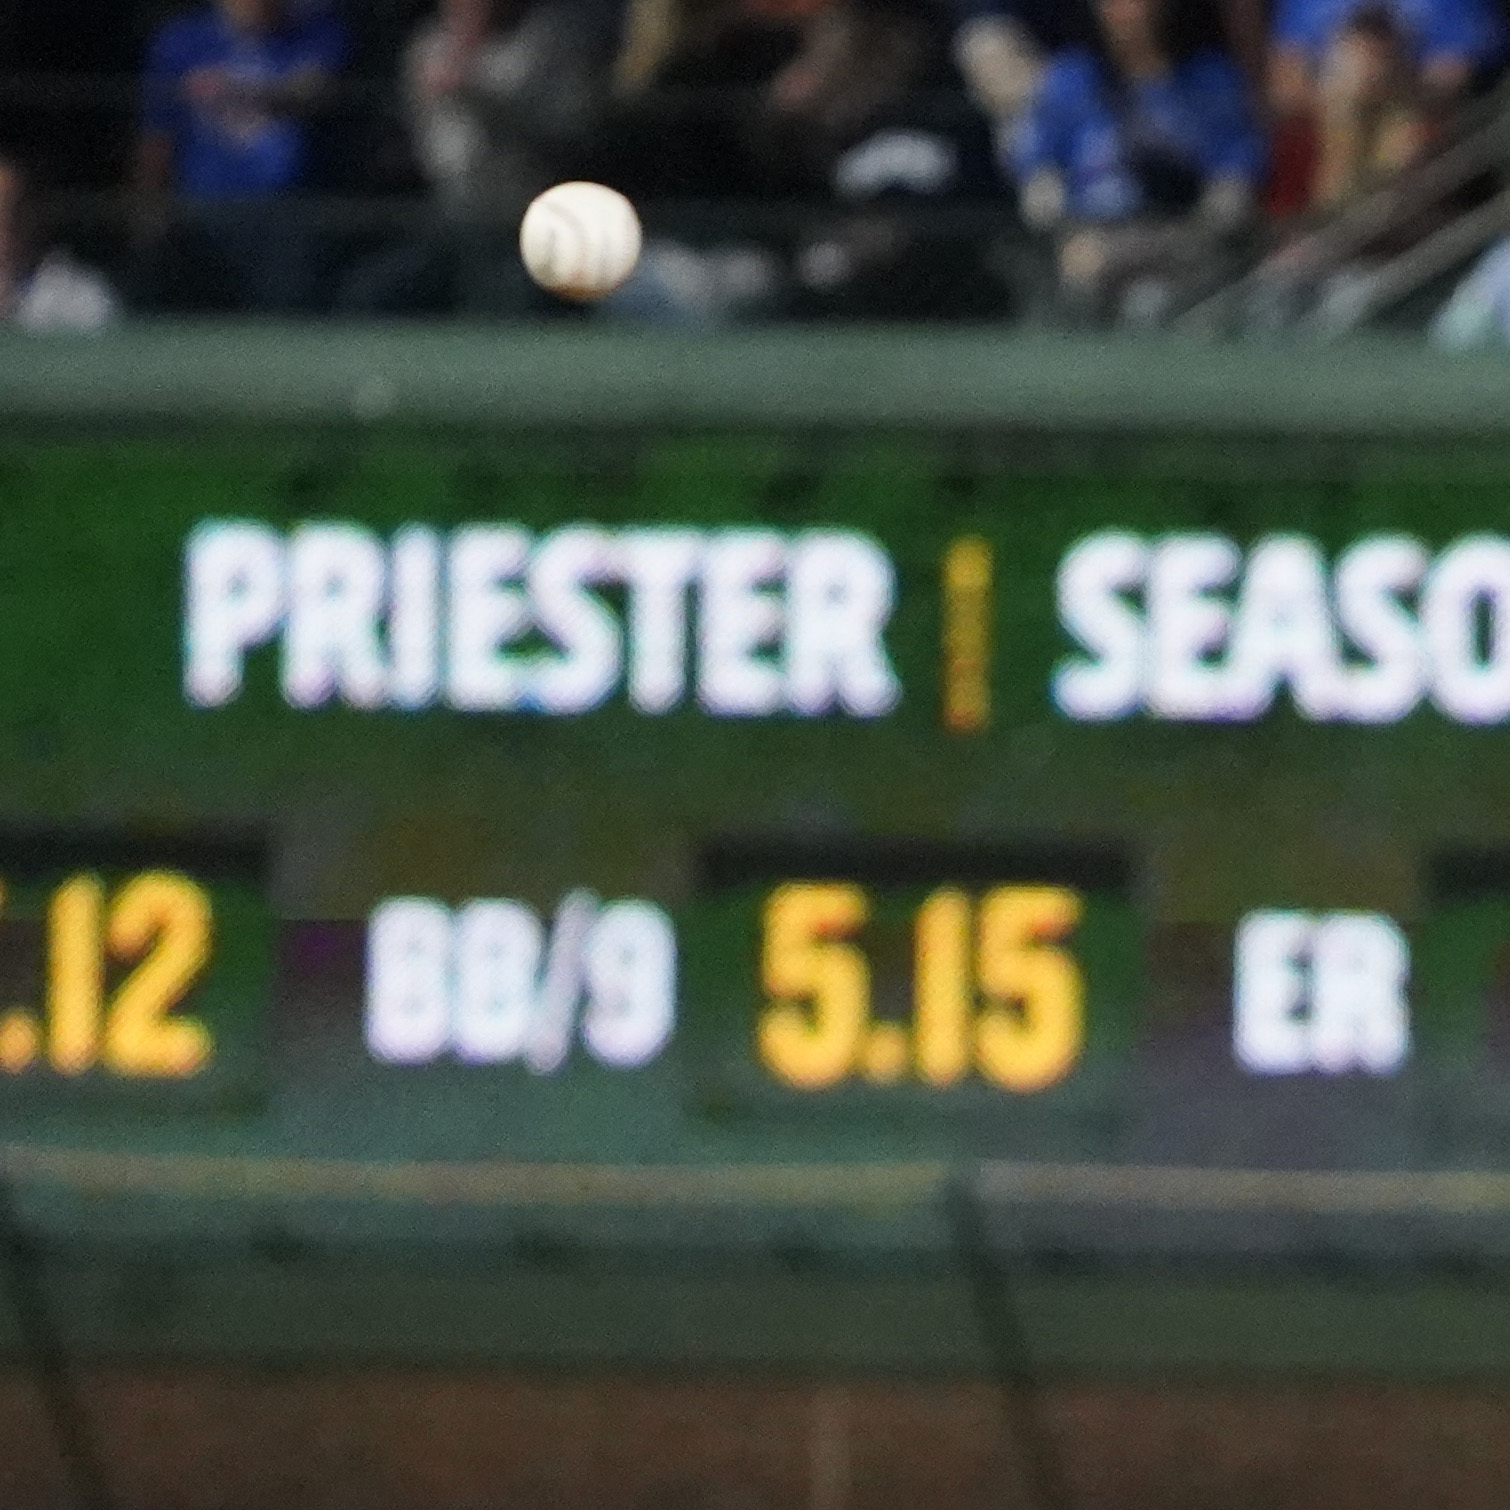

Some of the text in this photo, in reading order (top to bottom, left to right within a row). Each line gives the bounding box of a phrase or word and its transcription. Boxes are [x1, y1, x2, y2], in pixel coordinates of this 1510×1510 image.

[186, 521, 895, 715] PRIESTER
[0, 871, 212, 1077] .12
[366, 890, 677, 1073] BB/9
[757, 883, 1083, 1093] 5.15
[1232, 911, 1410, 1074] ER
